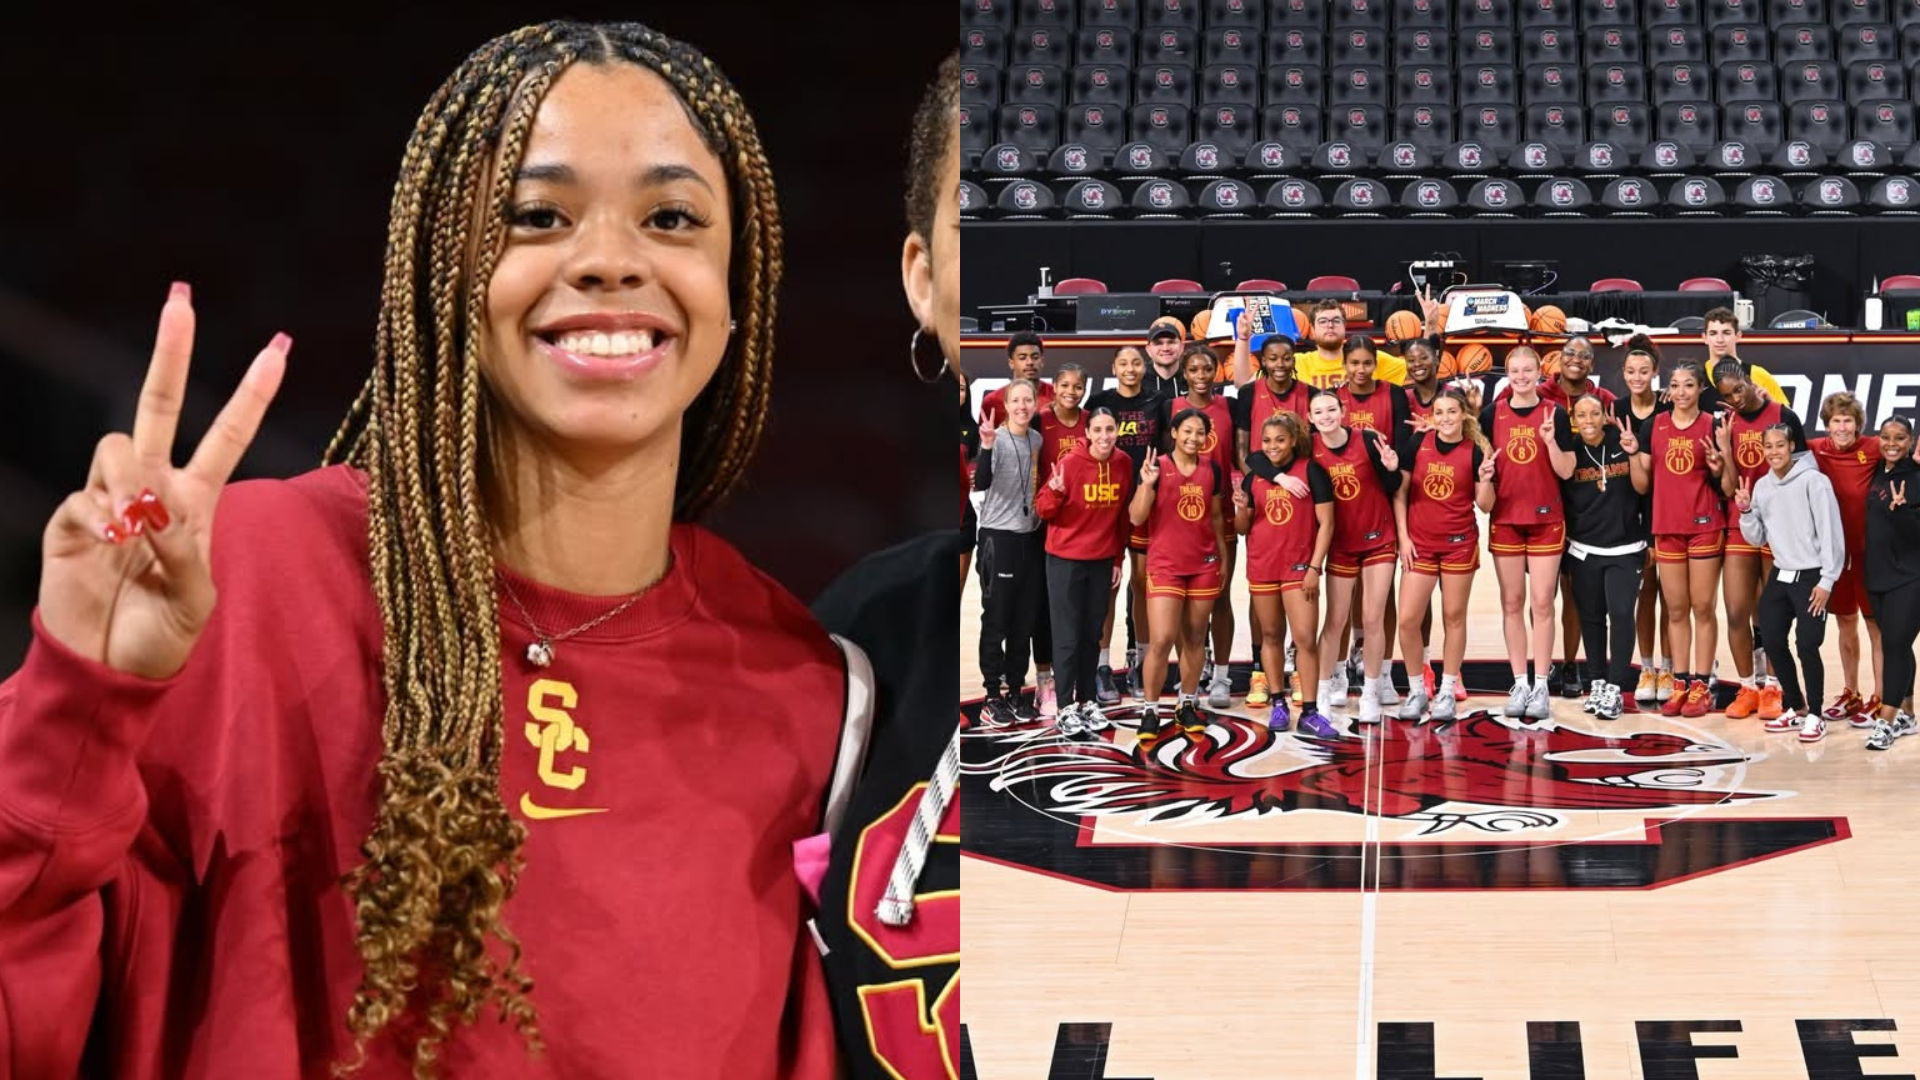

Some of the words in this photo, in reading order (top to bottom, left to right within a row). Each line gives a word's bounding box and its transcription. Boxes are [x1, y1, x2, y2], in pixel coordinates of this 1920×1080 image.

[1119, 410, 1145, 420] THE
[1510, 427, 1535, 438] TROJANS
[1738, 432, 1763, 443] TROJANS
[1668, 437, 1694, 449] TROJANS
[1518, 447, 1526, 459] 8
[1748, 452, 1754, 463] 0
[1675, 457, 1685, 471] 11
[1083, 483, 1121, 502] USC
[1342, 485, 1349, 496] 4
[1432, 484, 1445, 496] 24
[1187, 504, 1197, 517] 10
[1275, 509, 1282, 521] 3
